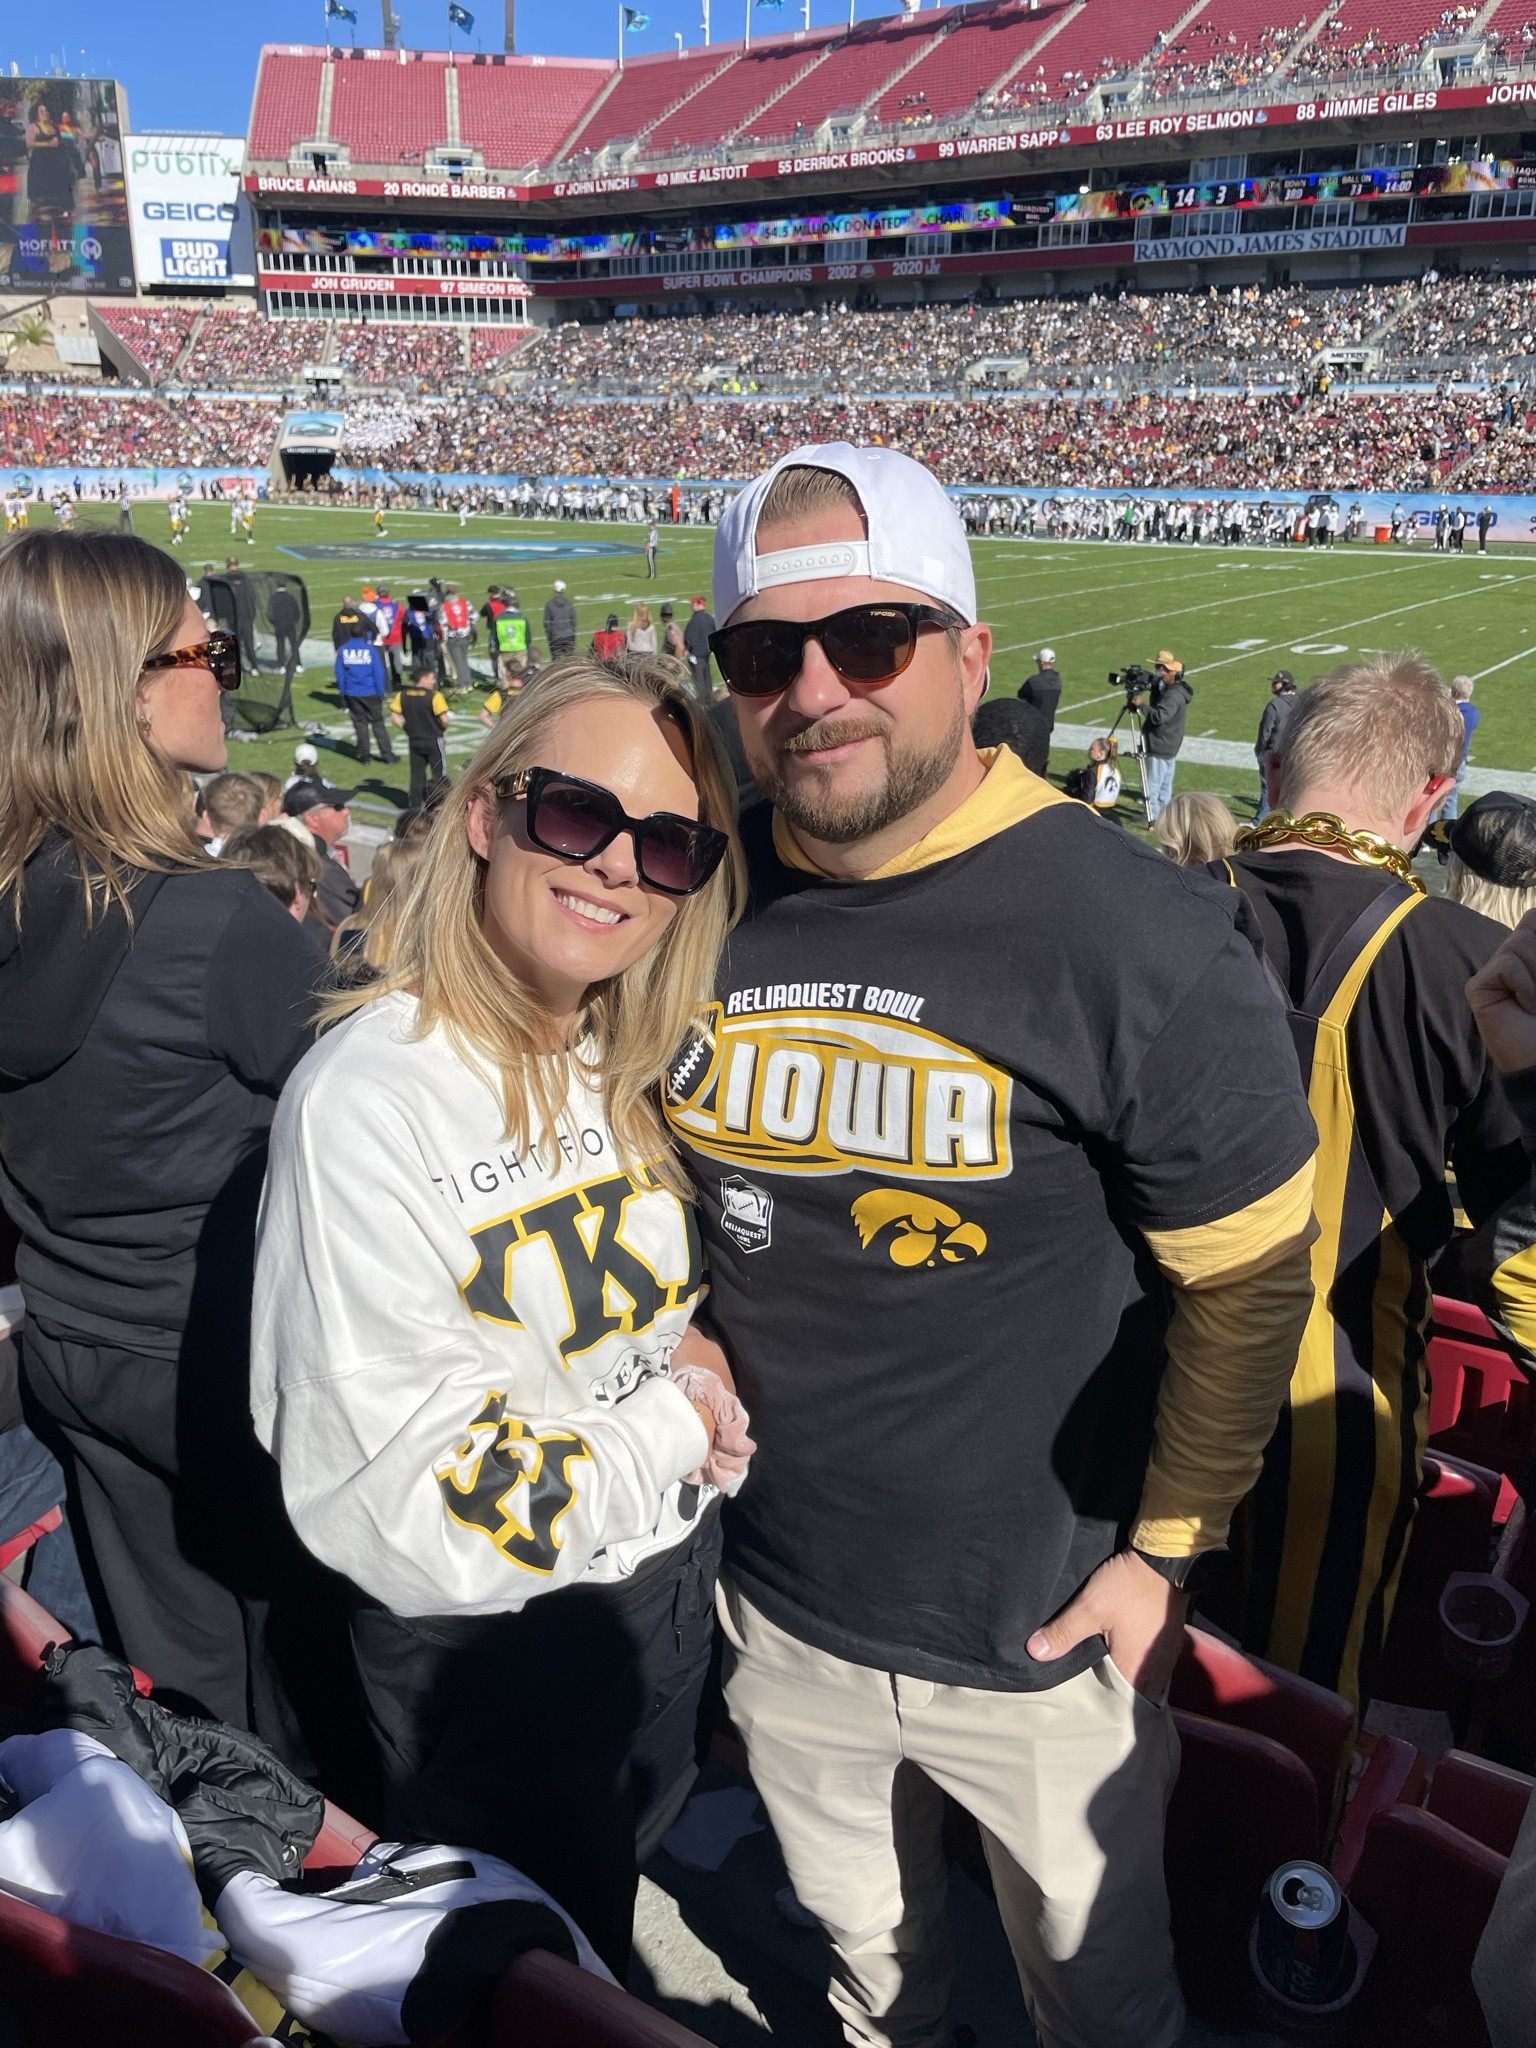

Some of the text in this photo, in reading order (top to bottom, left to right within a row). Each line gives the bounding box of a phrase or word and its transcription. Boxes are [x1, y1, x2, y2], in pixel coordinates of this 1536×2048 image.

[1486, 83, 1536, 104] JOHN
[1296, 92, 1438, 121] 88 JIMMIE GILES
[1096, 110, 1255, 141] 63 LEE ROY SELMON
[938, 130, 1058, 157] 99 WARREN SAPP
[778, 149, 905, 174] 55 DERRICK BROOKS
[258, 177, 358, 194] BRUCE ARIANS
[655, 164, 750, 187] 40 MIKE ALSTOTT
[384, 182, 400, 195] 20
[451, 185, 506, 199] BARBER
[554, 176, 630, 197] 47 JOHN LYNCH
[1215, 185, 1228, 205] 3
[1384, 180, 1412, 194] 14:00
[1174, 187, 1196, 208] 14
[143, 202, 240, 222] GEICO
[844, 216, 902, 232] DONATED
[171, 241, 220, 259] BUD
[1136, 226, 1403, 260] RAYMOND JAMES STADIUM
[165, 257, 228, 277] LIGHT
[827, 265, 857, 280] 2002
[892, 261, 923, 276] 2020
[311, 277, 395, 291] JON GRUDEN
[663, 266, 813, 290] SUPER BOWL CHAMPIONS
[440, 281, 455, 293] 97
[457, 282, 506, 296] SIMEON
[727, 982, 926, 1023] RELIAQUEST BOWL
[723, 1040, 999, 1168] IOWA
[724, 1220, 762, 1240] RELIAQUEST
